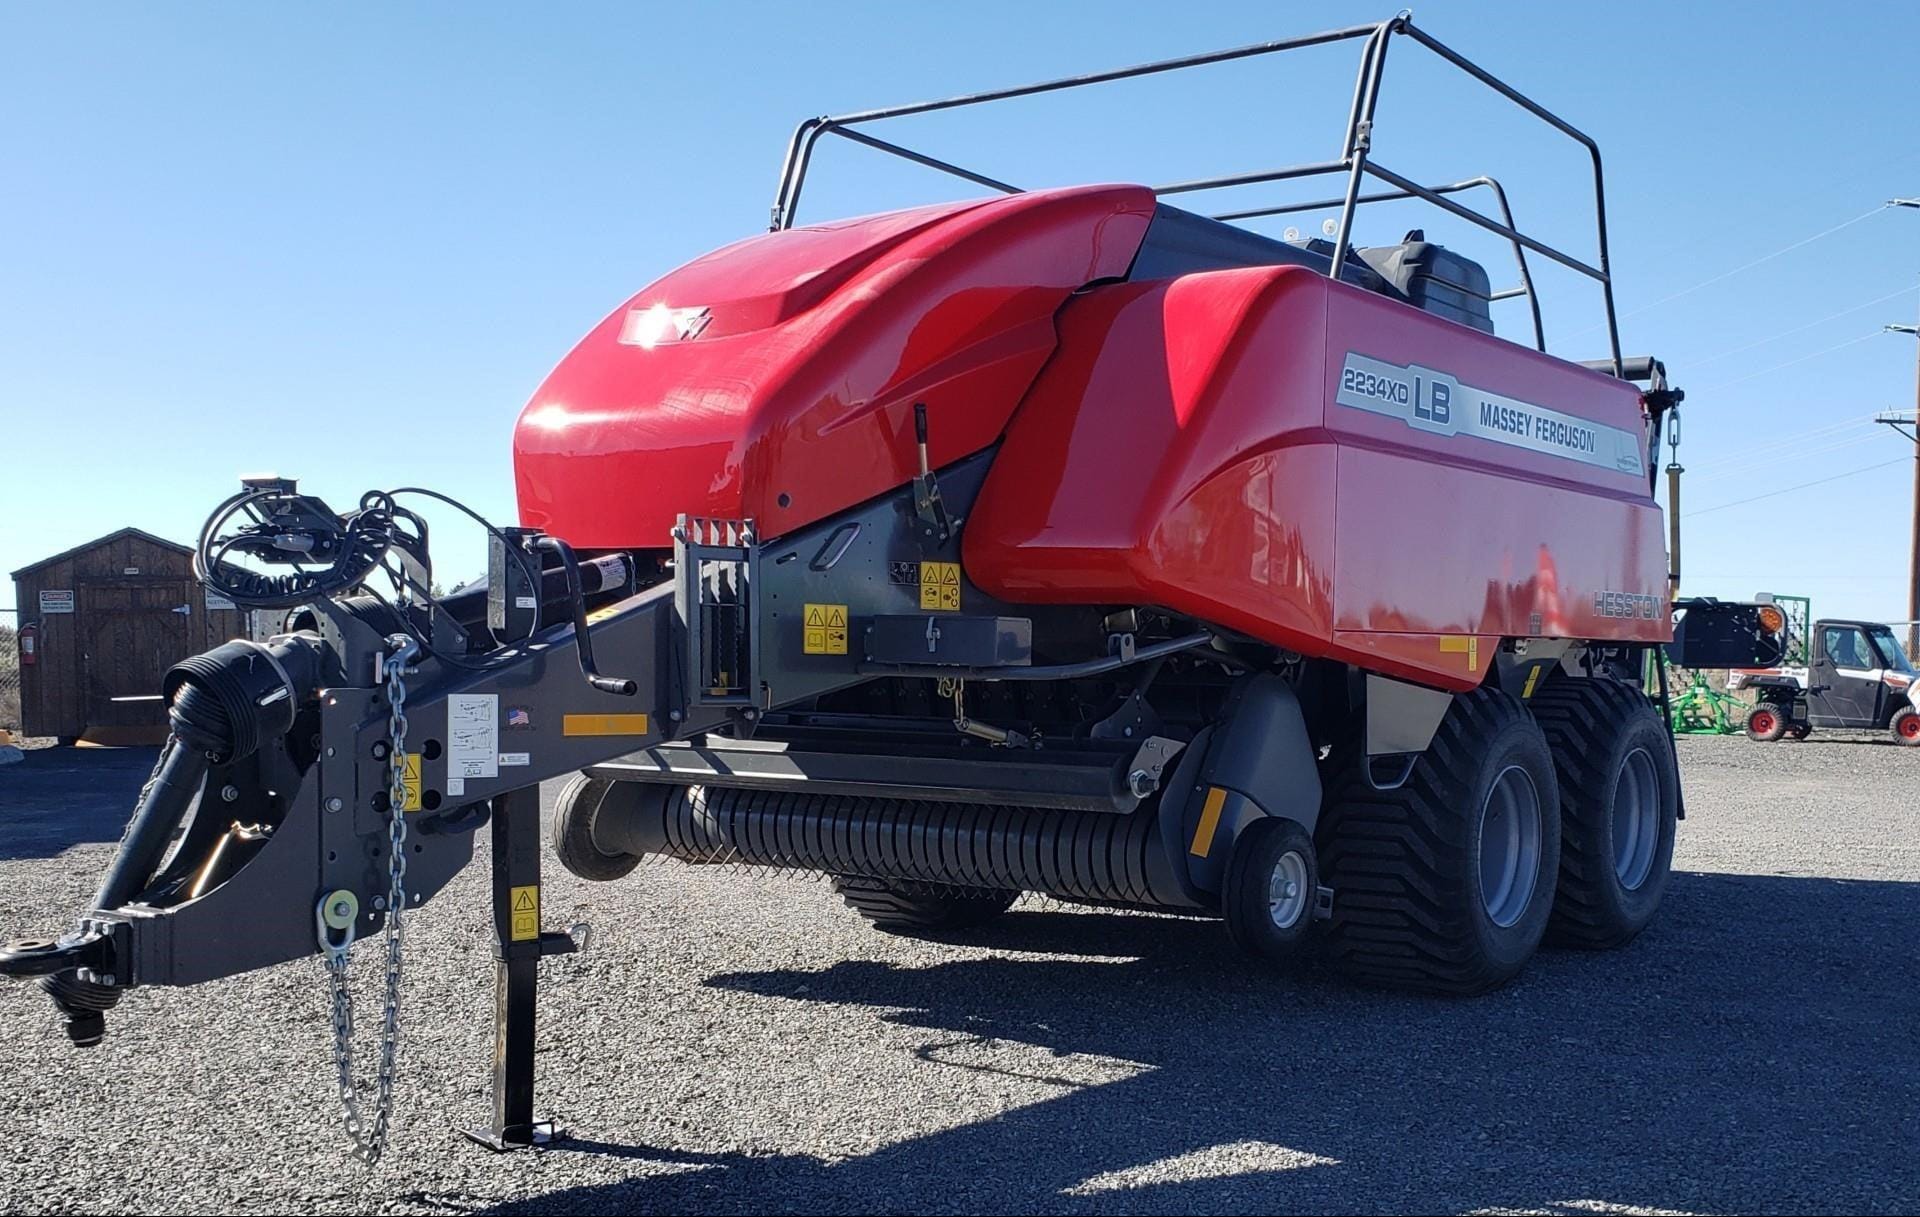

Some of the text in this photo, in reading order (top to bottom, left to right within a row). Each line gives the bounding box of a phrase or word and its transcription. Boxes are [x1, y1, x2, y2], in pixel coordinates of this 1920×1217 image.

[1344, 368, 1450, 425] 2234XD LB
[1480, 402, 1595, 452] MASSEY FERGUSON
[1593, 591, 1663, 621] HESSTON
